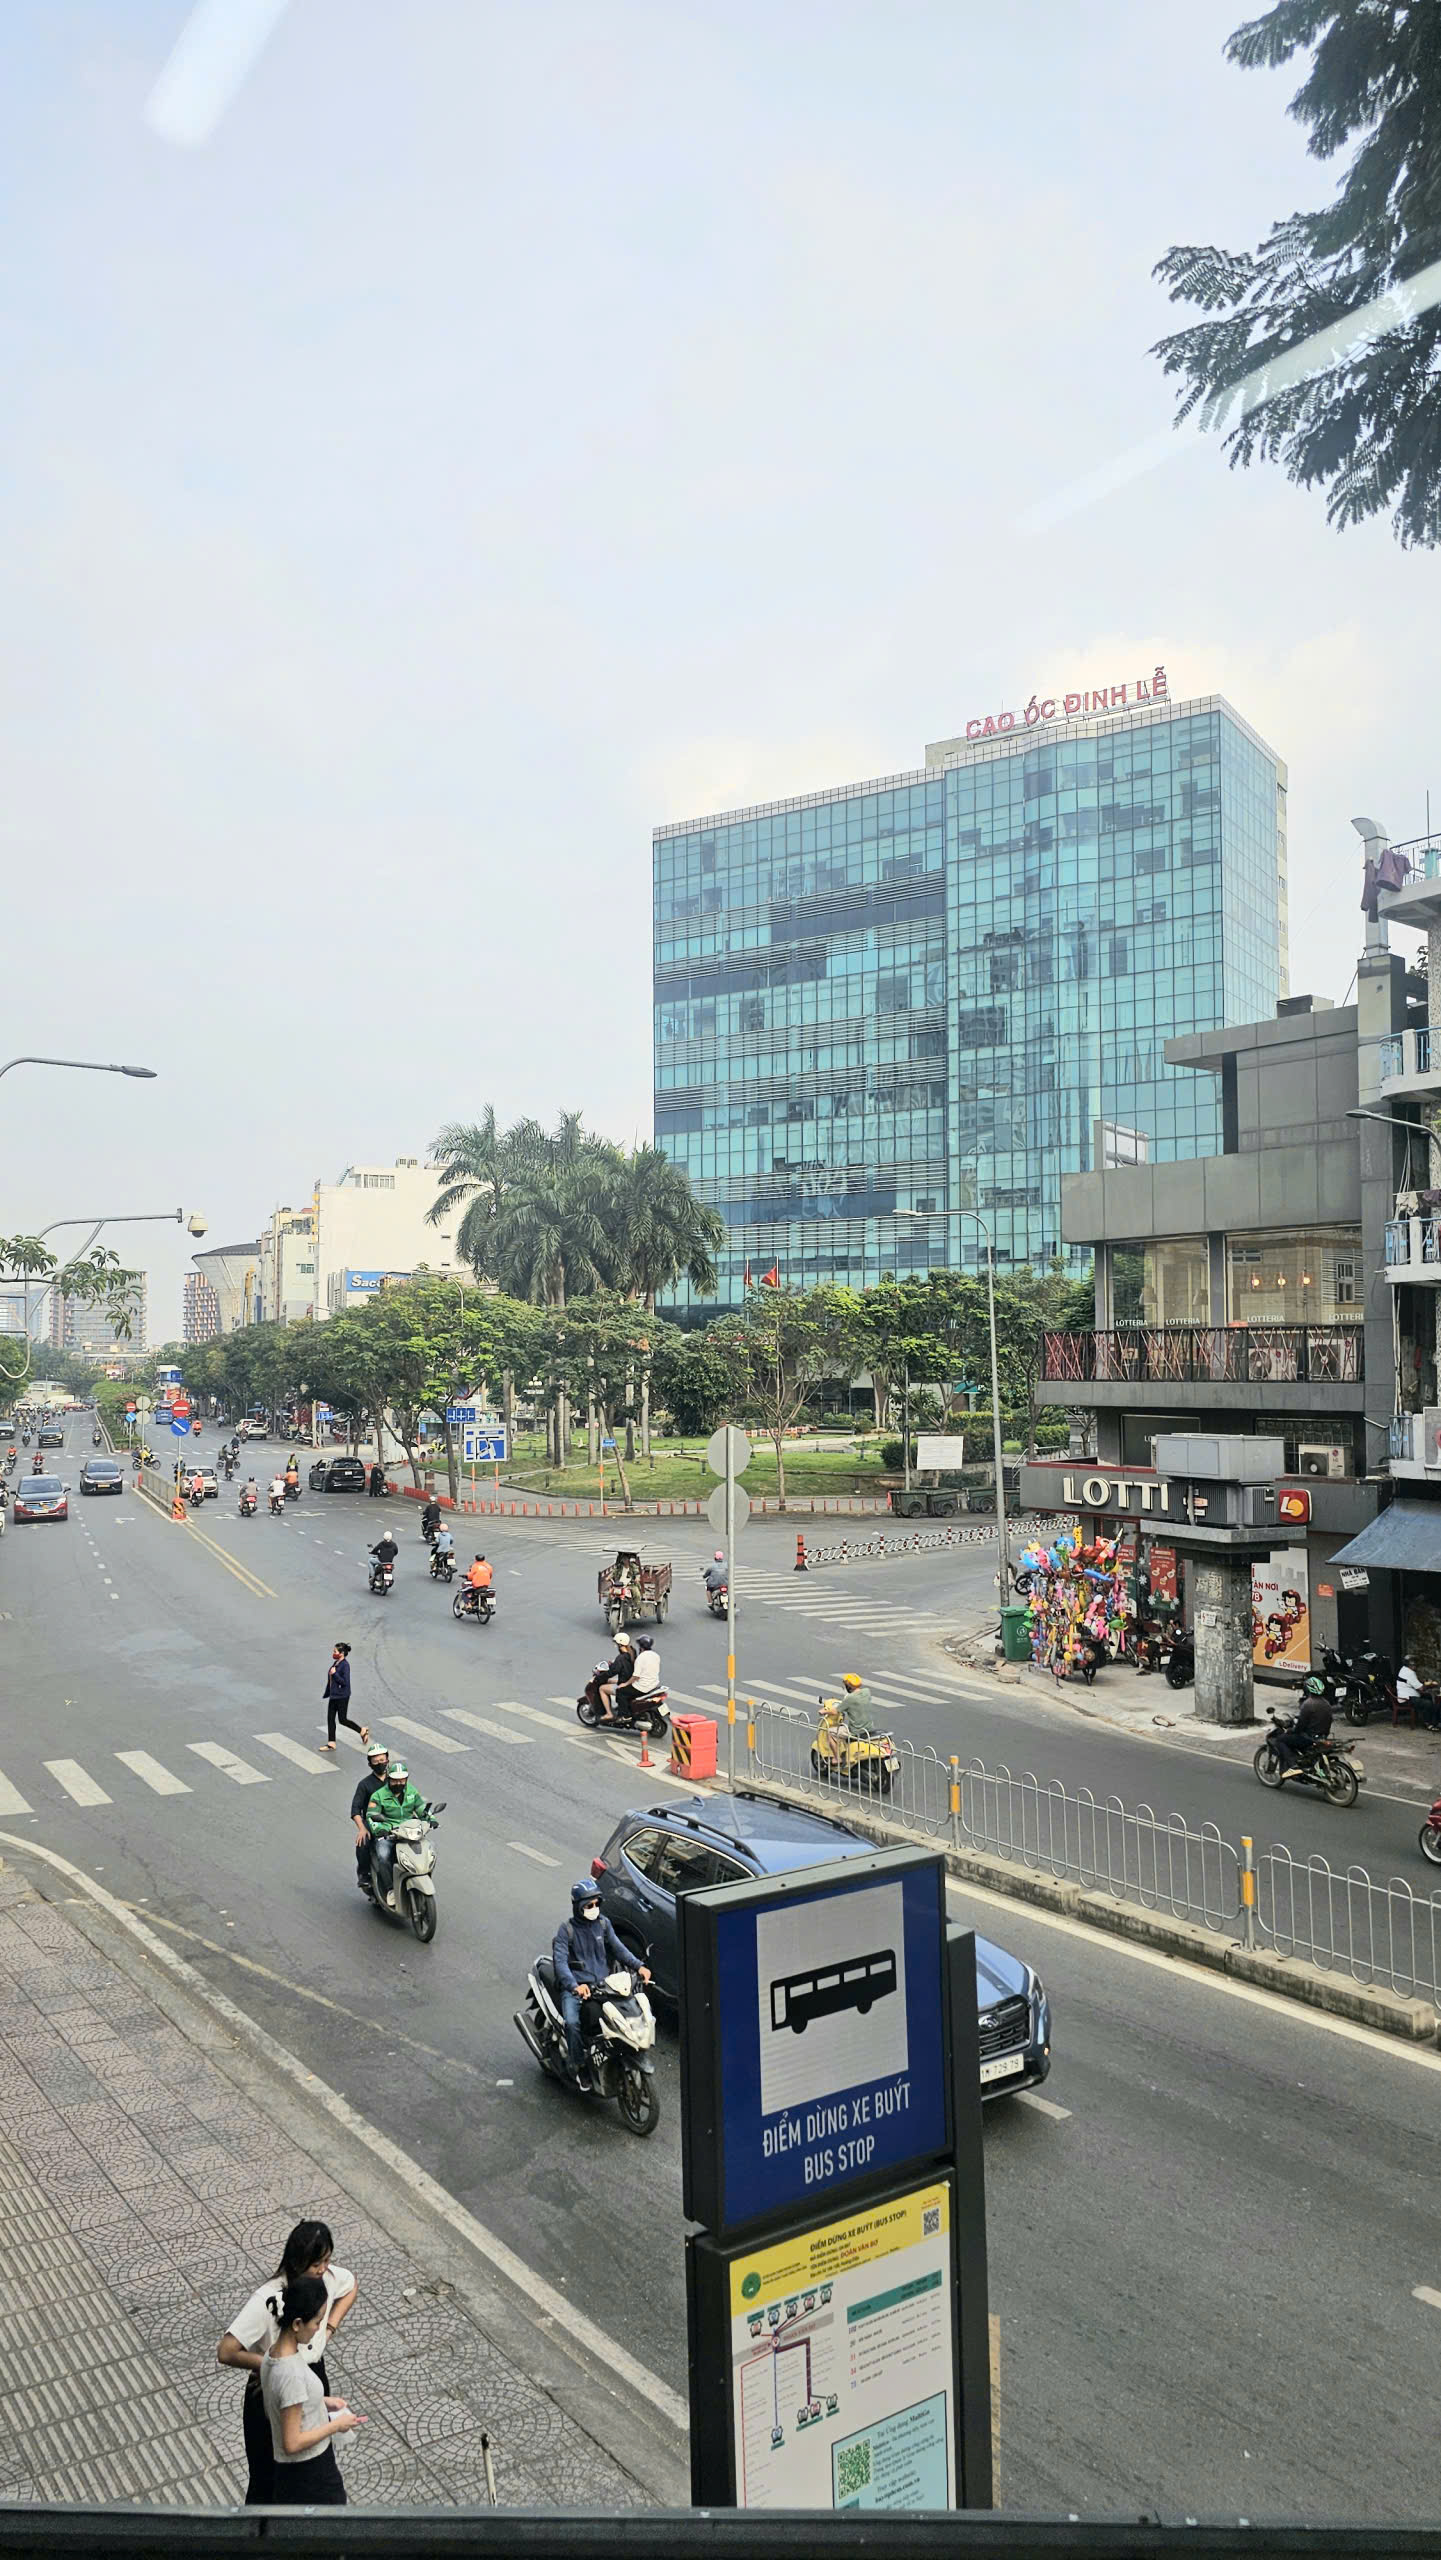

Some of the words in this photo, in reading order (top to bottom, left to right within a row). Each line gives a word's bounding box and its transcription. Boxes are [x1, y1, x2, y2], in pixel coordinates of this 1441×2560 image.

[966, 712, 1015, 739] CAO
[1065, 684, 1127, 714] ĐINH
[1137, 666, 1167, 700] LỄ
[1247, 1314, 1285, 1322] LOTTERIA
[1328, 1313, 1364, 1321] LOTTERI
[1115, 1319, 1148, 1327] LOTTERIA
[1165, 1318, 1200, 1326] LOTTERIA
[763, 2111, 801, 2157] ĐIỂM
[807, 2105, 847, 2142] DỪNG
[852, 2096, 871, 2127] XE
[875, 2078, 911, 2119] BUÝT
[804, 2149, 834, 2184] BUS
[838, 2135, 875, 2171] STOP
